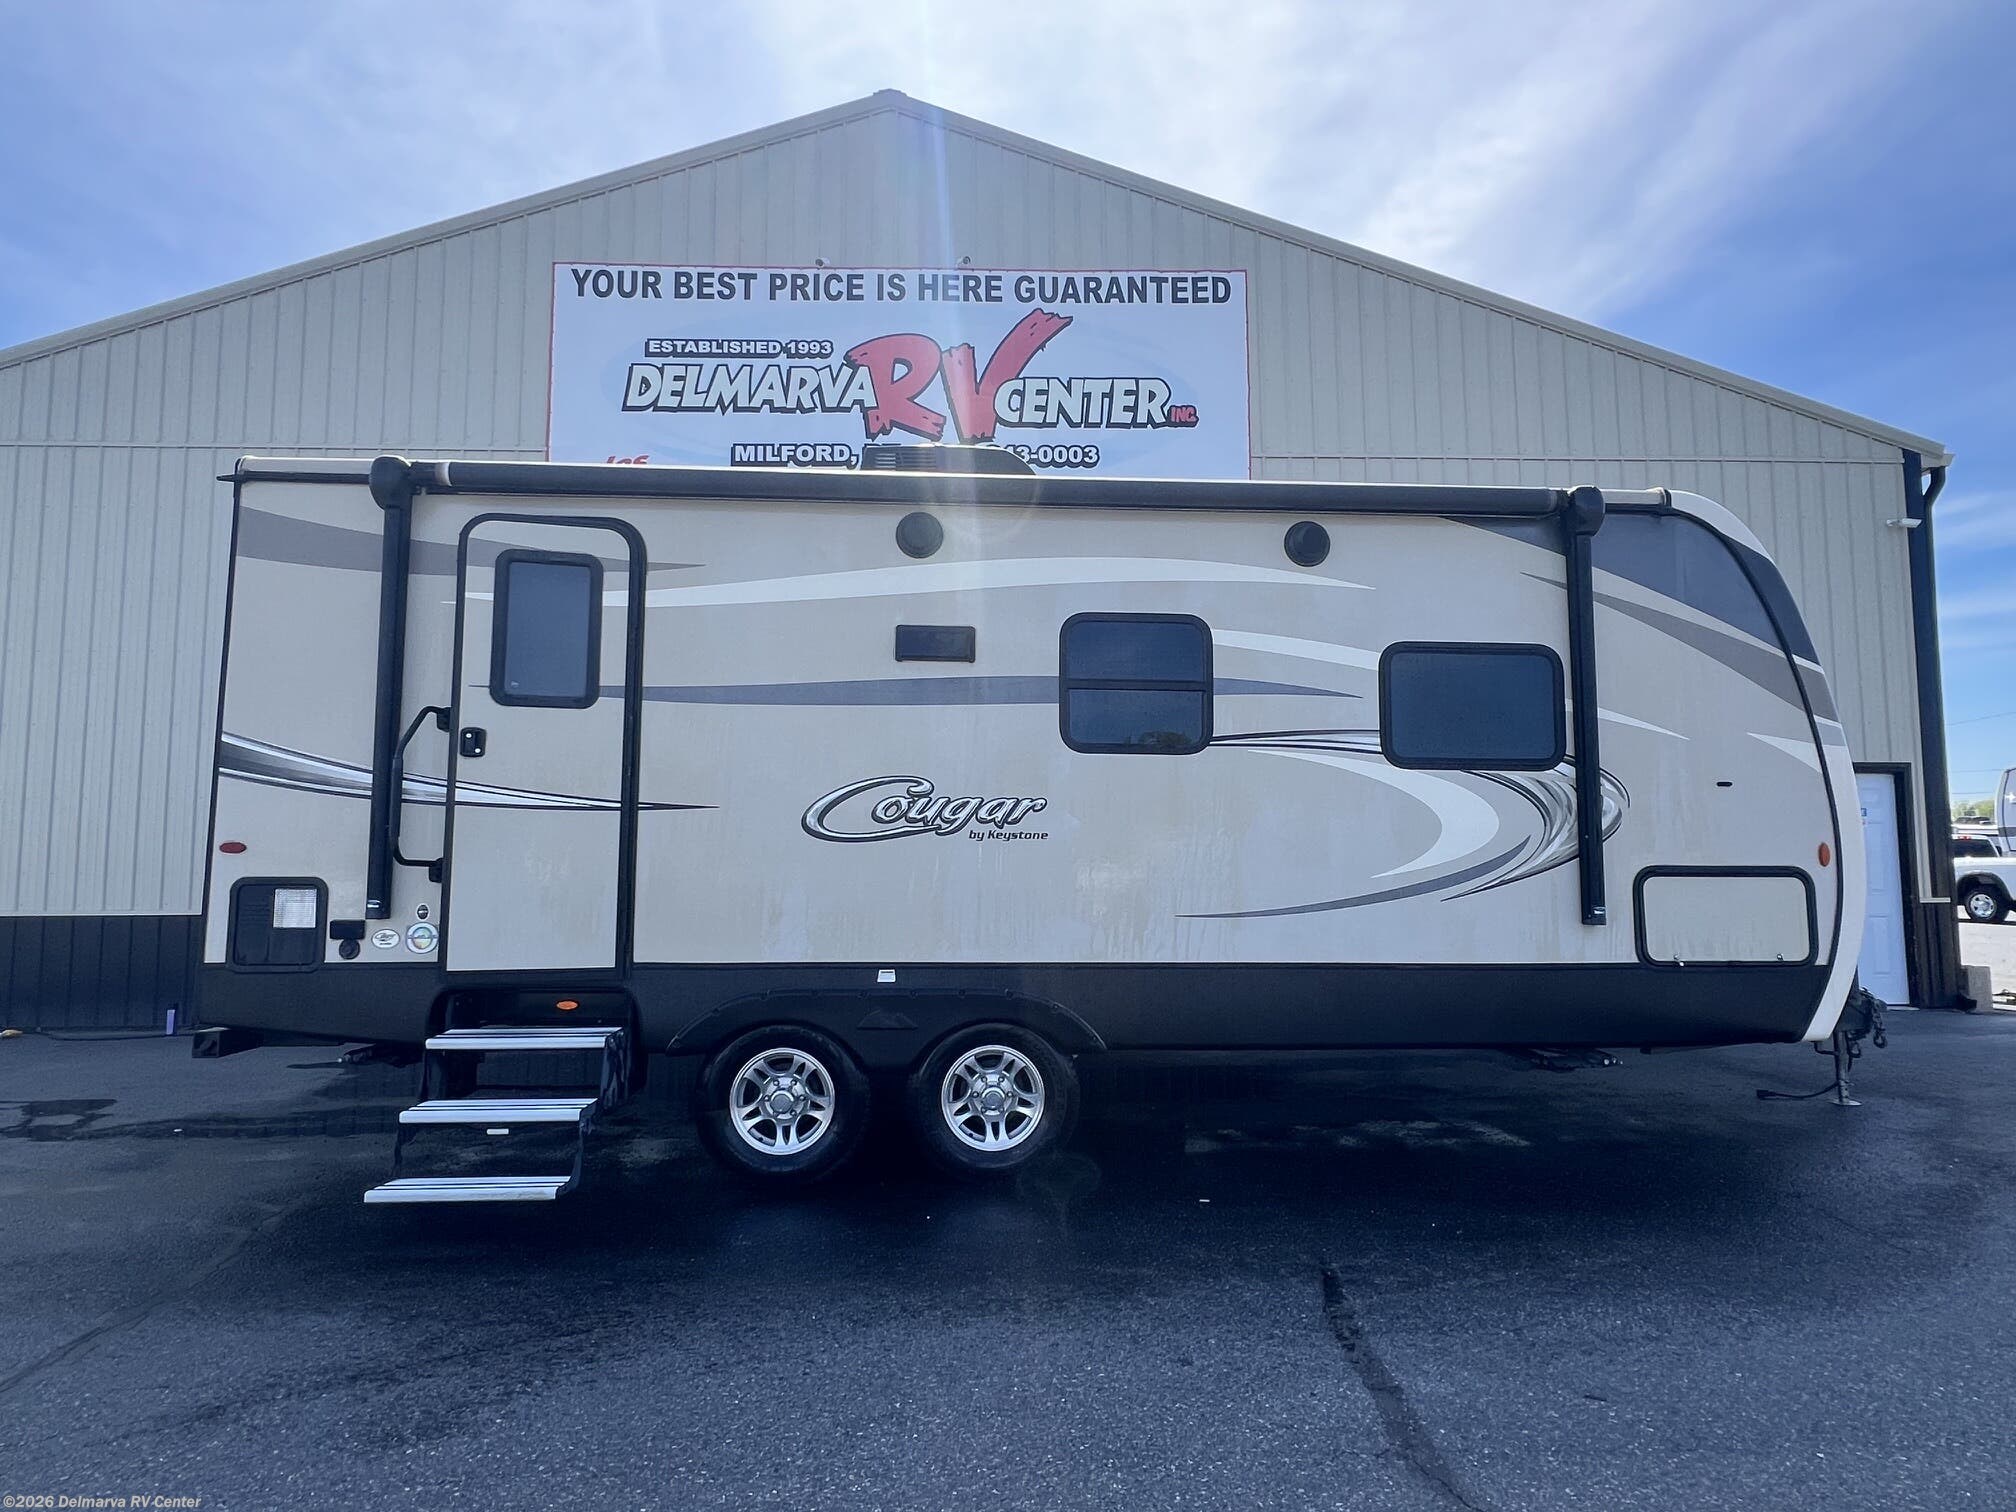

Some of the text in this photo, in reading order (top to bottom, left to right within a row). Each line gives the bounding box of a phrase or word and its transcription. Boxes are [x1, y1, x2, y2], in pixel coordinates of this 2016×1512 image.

[571, 268, 1232, 304] YOUR BEST PRICE IS HERE GUARANTEED
[646, 339, 834, 358] ESTABLISHED 1993
[621, 362, 878, 415] DELMARVA
[845, 308, 1074, 443] RV
[994, 376, 1172, 429] CENTER
[731, 443, 860, 469] MILFORD,
[801, 775, 1048, 843] Cougar
[968, 829, 1049, 842] by Keystone
